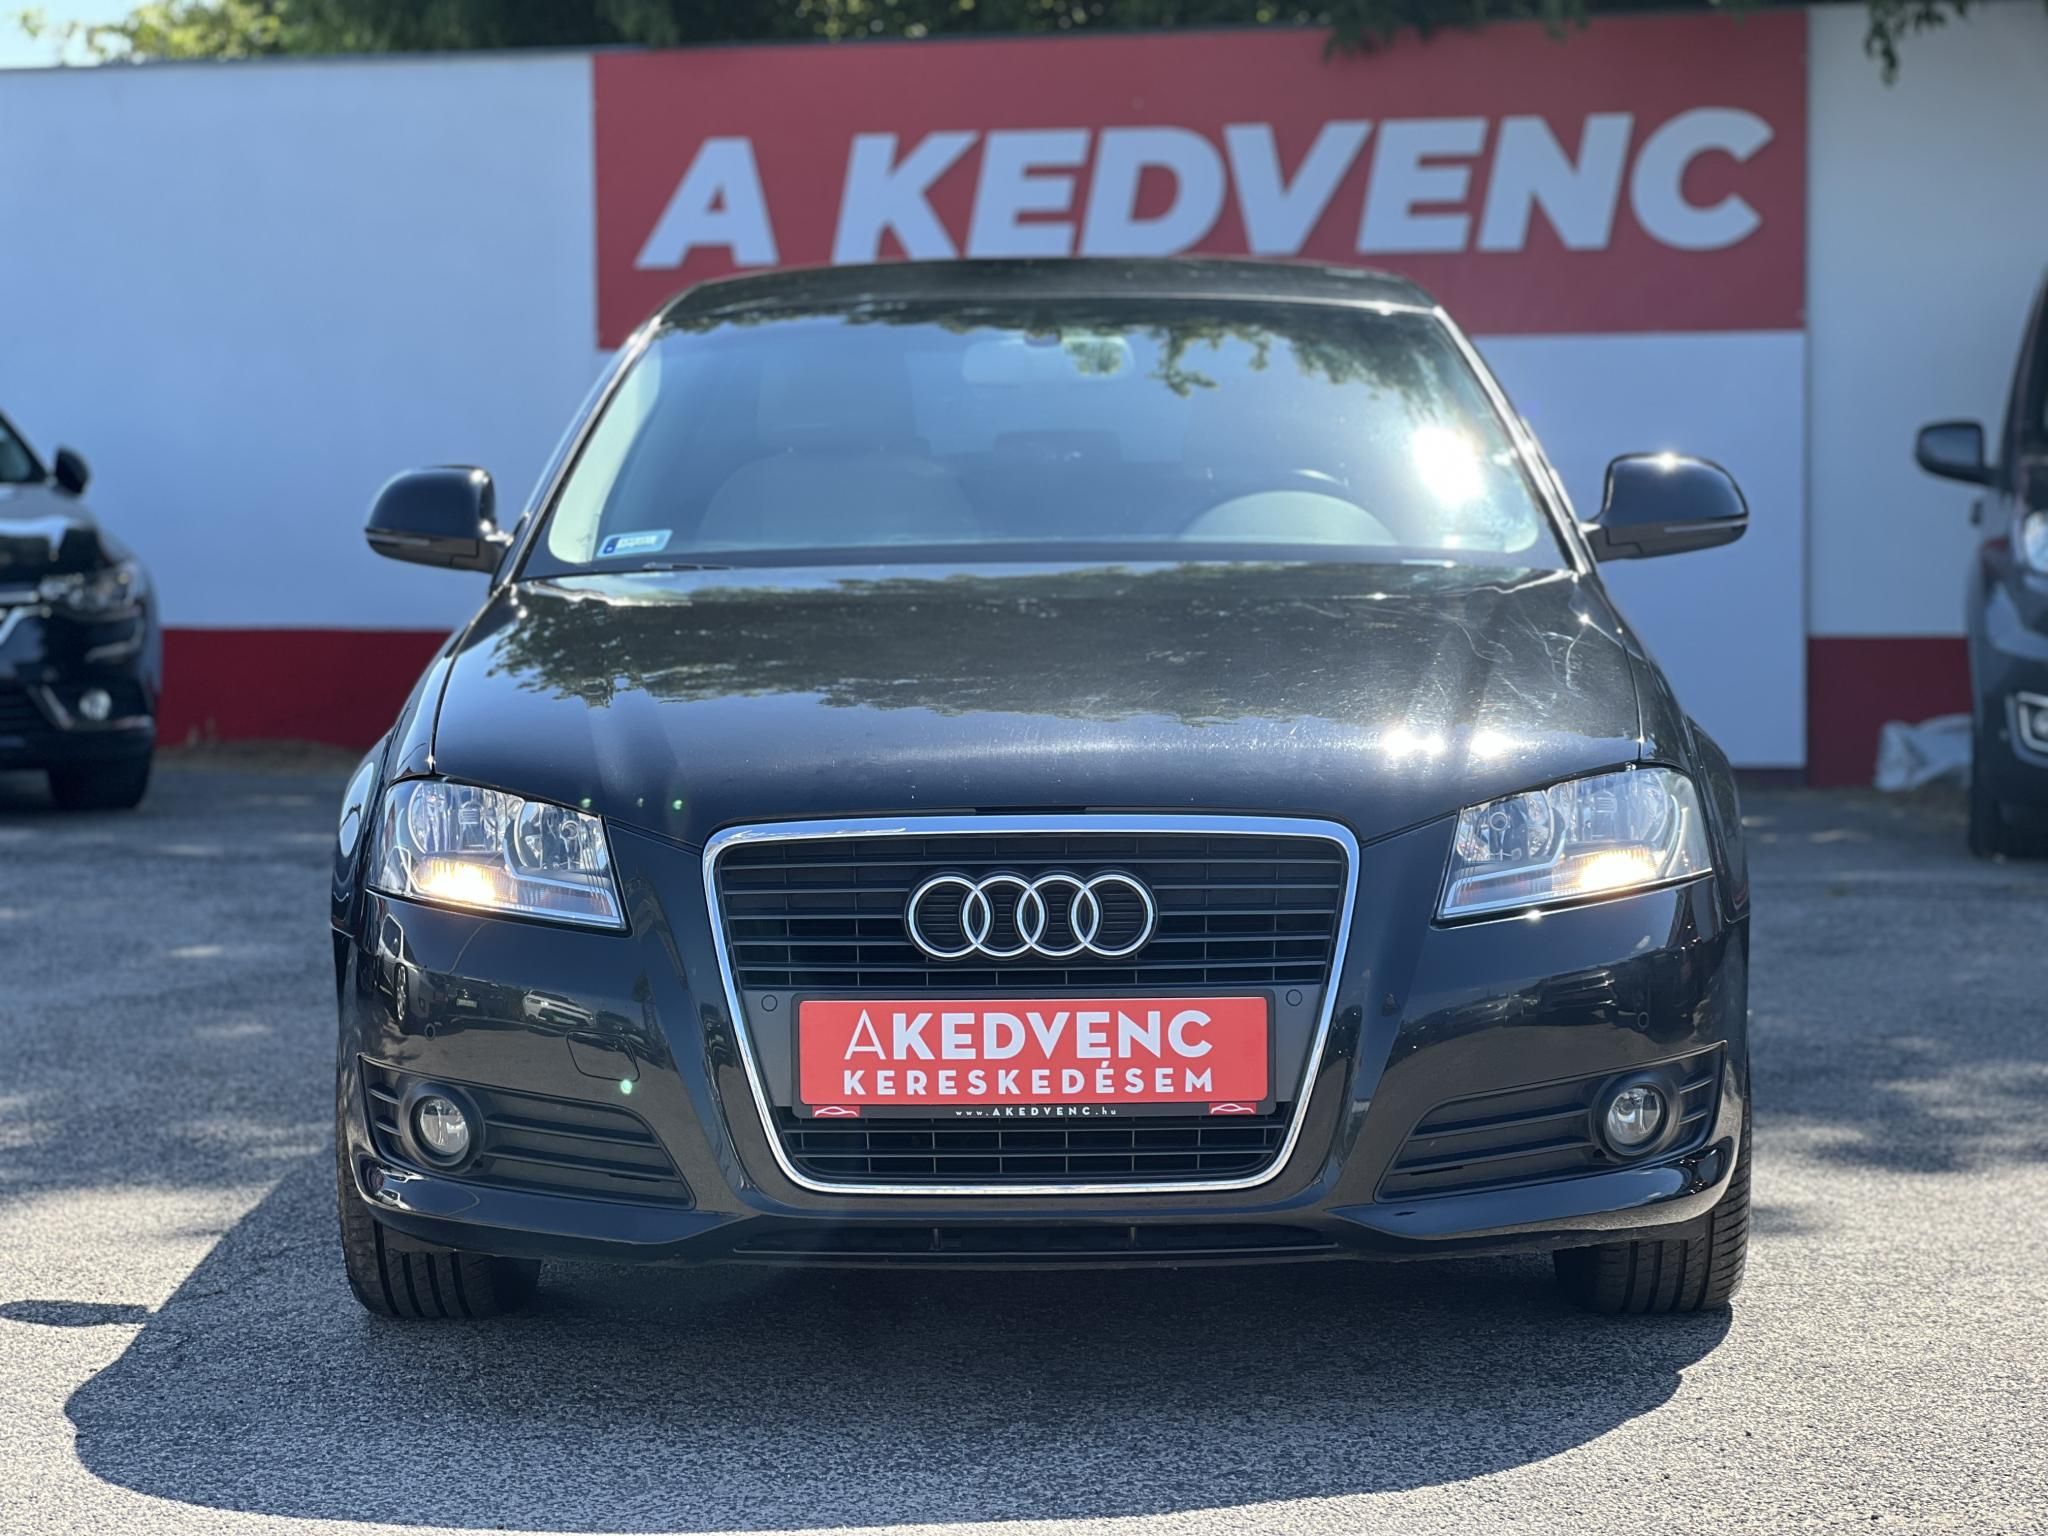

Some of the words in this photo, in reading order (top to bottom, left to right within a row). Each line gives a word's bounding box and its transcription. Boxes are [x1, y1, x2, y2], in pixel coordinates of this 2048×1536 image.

[634, 136, 779, 268] A
[831, 109, 1772, 265] KEDVENC
[843, 1060, 1213, 1096] KERESKEDÉSEM
